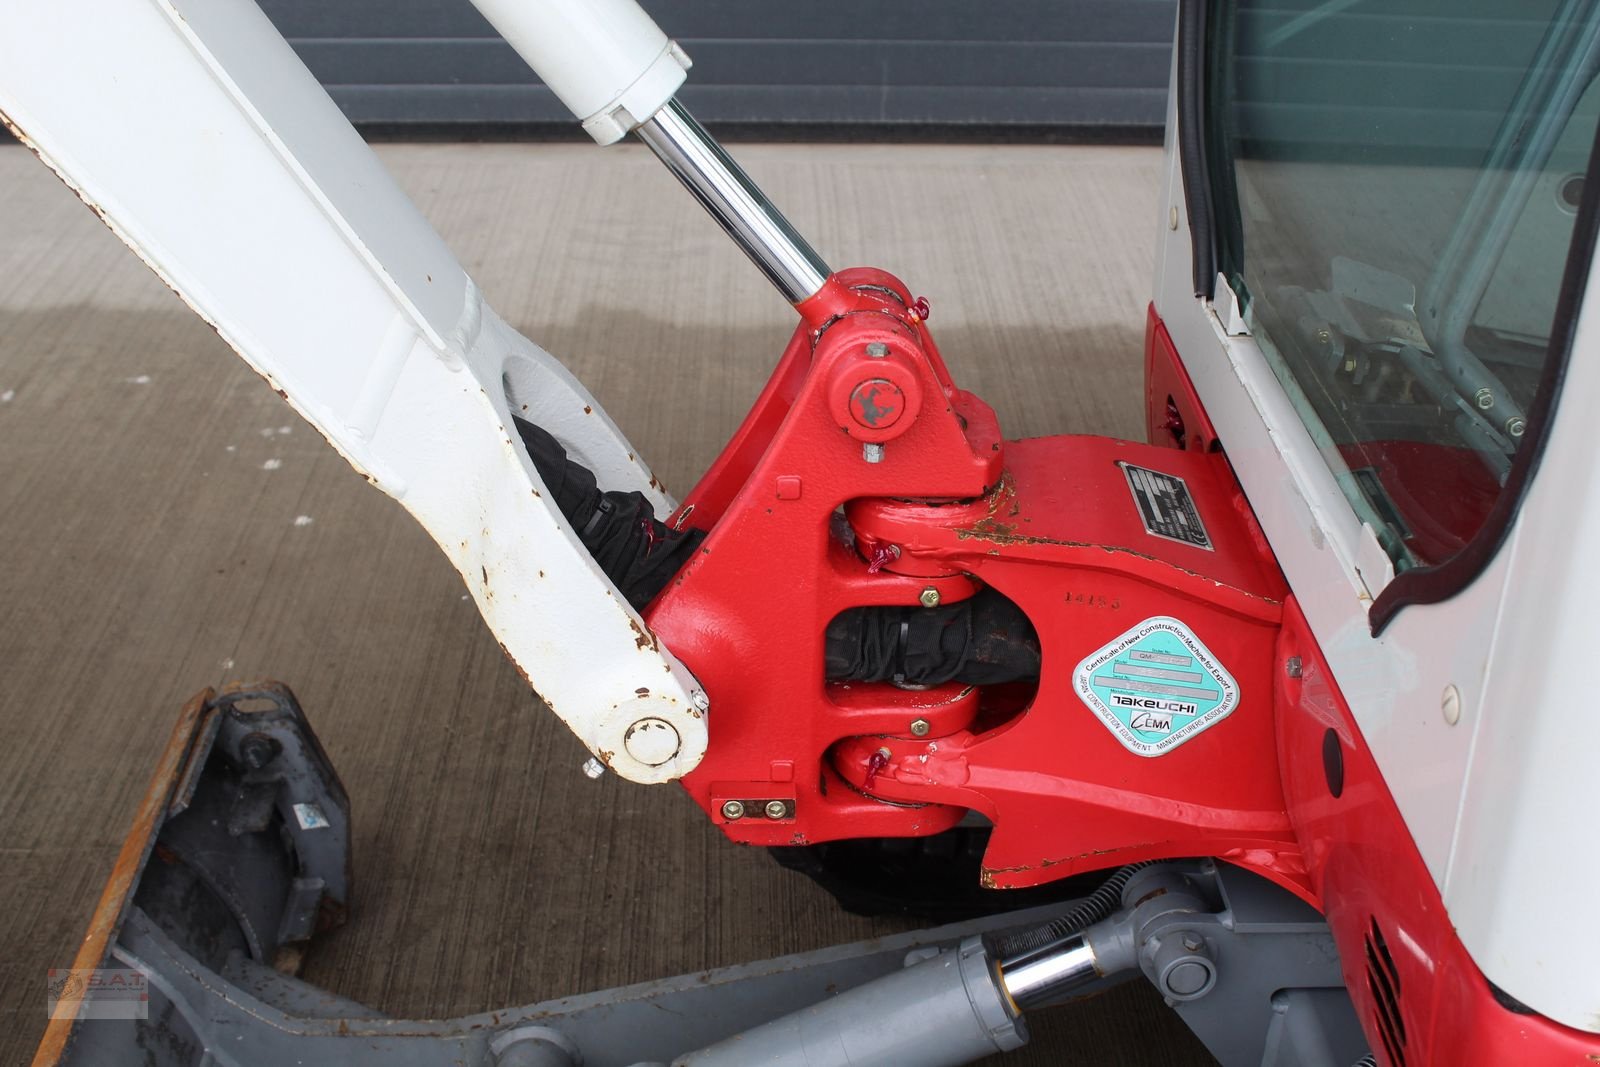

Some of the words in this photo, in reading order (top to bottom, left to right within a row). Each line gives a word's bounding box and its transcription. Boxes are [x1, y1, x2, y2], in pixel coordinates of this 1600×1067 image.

[1085, 648, 1120, 671] Certificate
[1119, 642, 1126, 651] of
[1124, 634, 1141, 646] New
[1140, 623, 1186, 640] Construction
[1184, 637, 1207, 662] Machine
[1204, 660, 1214, 670] for
[1211, 668, 1231, 690] Export
[1080, 674, 1089, 693] JAPAN
[1087, 693, 1121, 729] CONSTRUCTION
[1119, 728, 1151, 751] EQUIPMENT
[1204, 692, 1233, 722] ASSOCIATION
